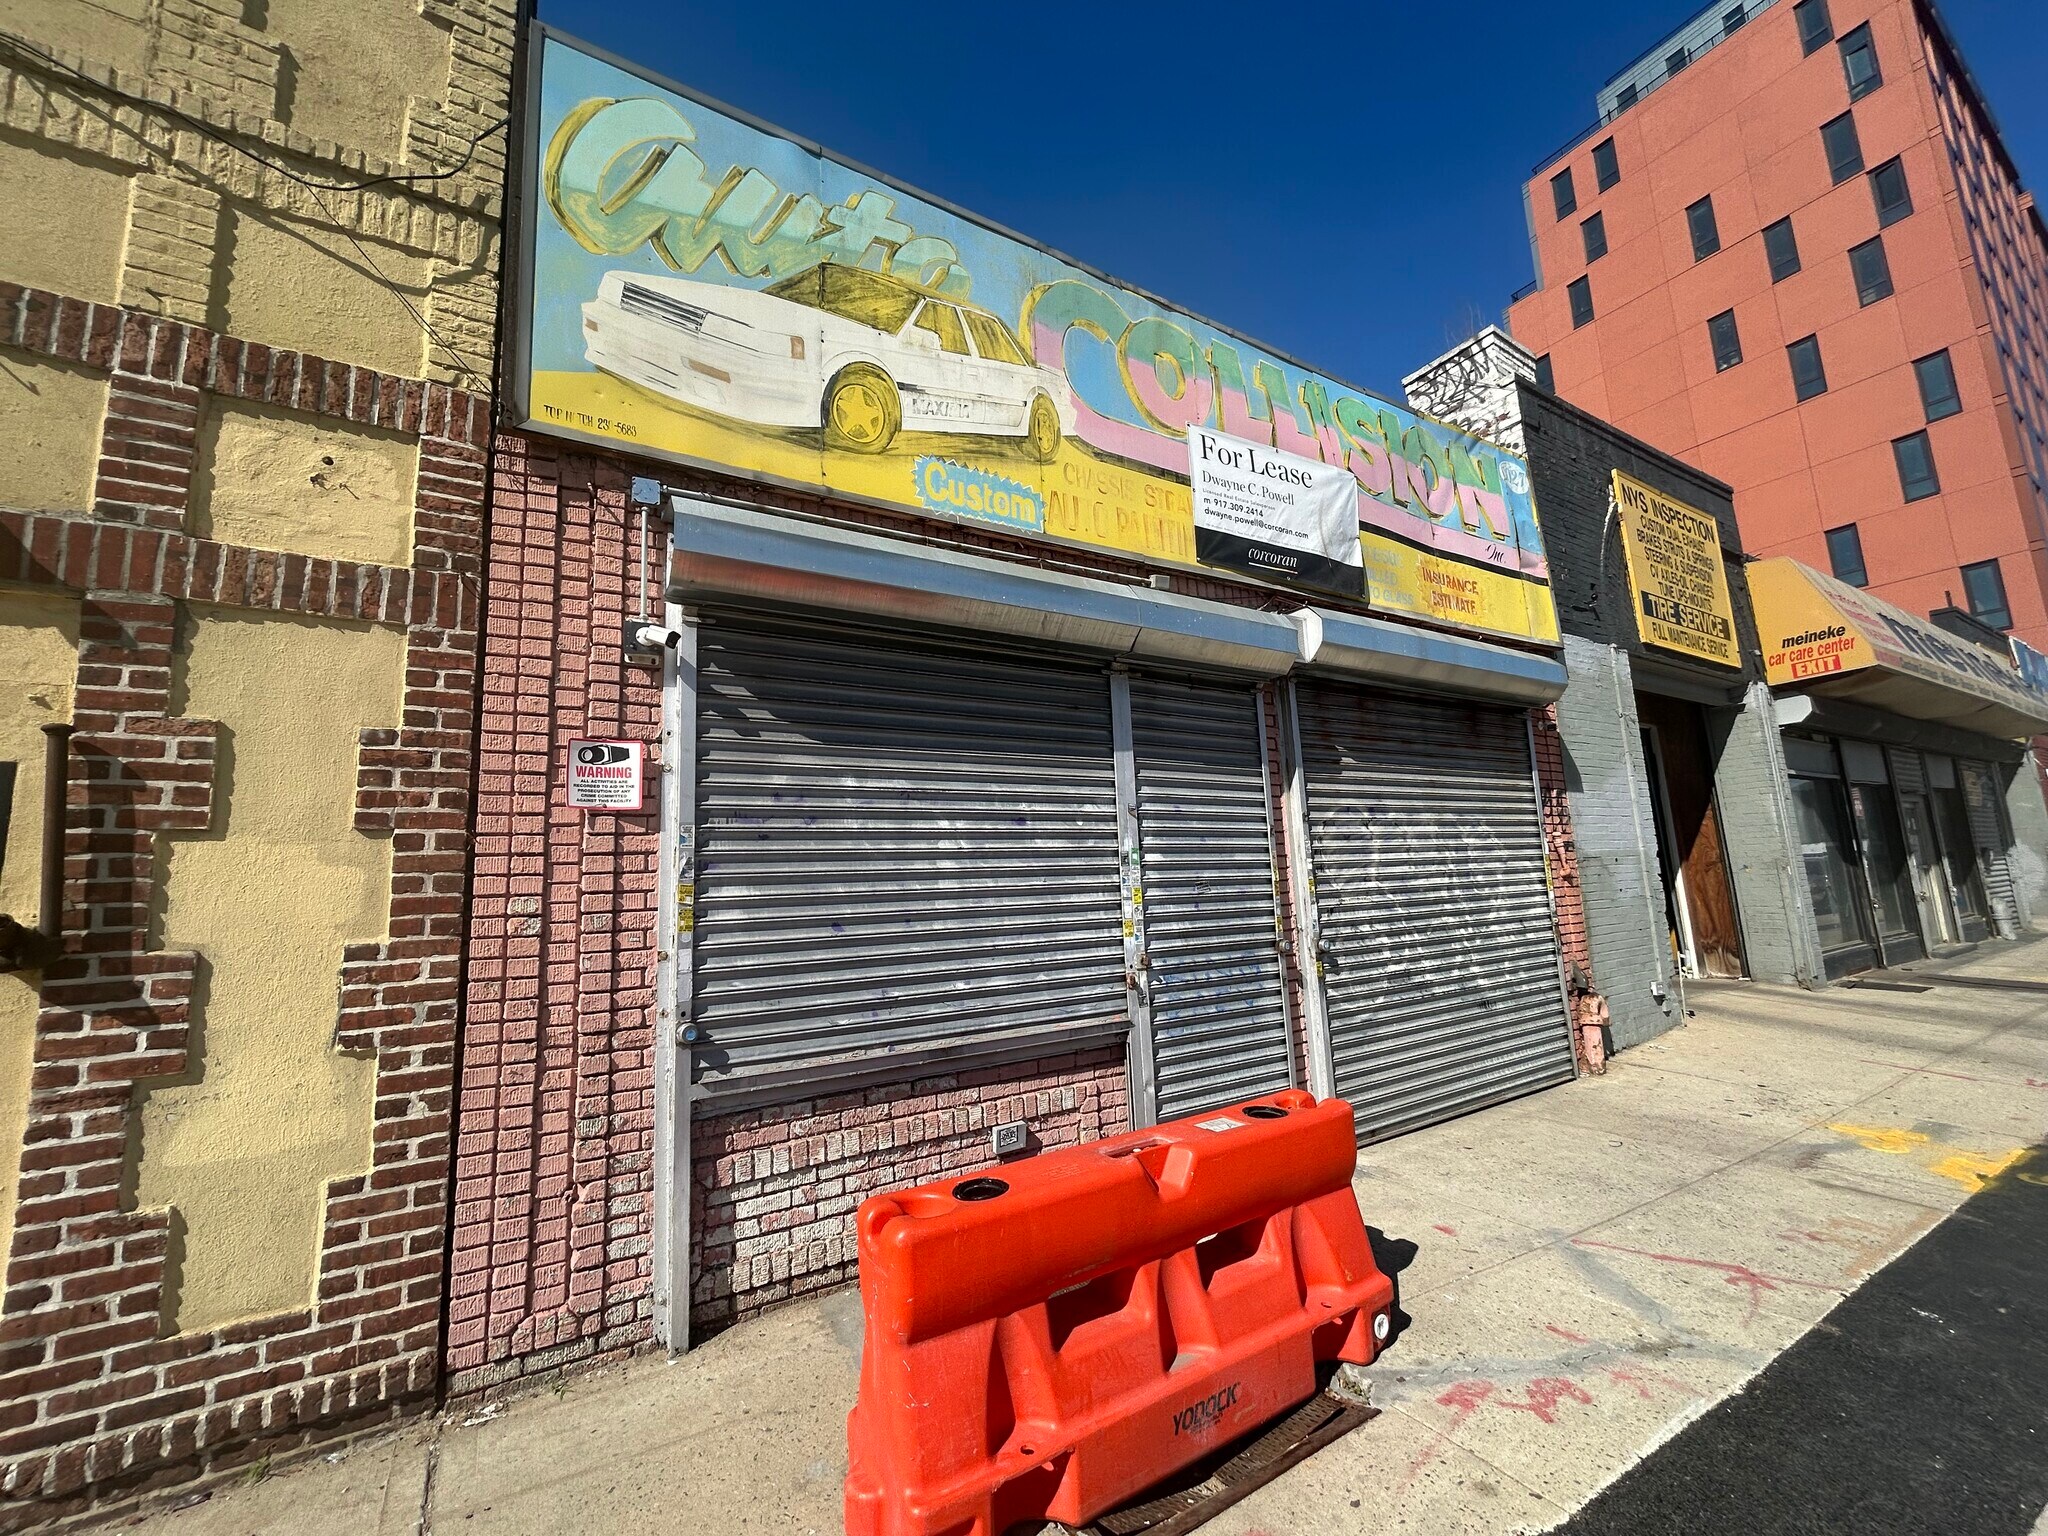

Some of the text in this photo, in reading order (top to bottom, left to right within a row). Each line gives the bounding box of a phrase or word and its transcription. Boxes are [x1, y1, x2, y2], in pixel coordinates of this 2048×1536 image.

[598, 418, 637, 438] 23-5683
[1200, 433, 1313, 489] For Lease
[924, 462, 1036, 524] Custom
[1202, 470, 1295, 506] Dwayne C. Powell
[1204, 507, 1309, 539] dwayne.powell@corcoran.com
[1213, 498, 1264, 517] 917.309.2414
[1621, 483, 1716, 545] NYS INSPECTION
[1636, 528, 1662, 551] BRAKES
[1663, 539, 1686, 560] STRUTS
[1691, 550, 1715, 572] SPRINGS
[1640, 514, 1707, 554] CUSTOM DUAL EXHAUST
[1248, 546, 1298, 568] corcoran
[1485, 543, 1507, 564] Inc.
[1644, 545, 1673, 570] STEERING
[1680, 560, 1714, 585] SUSPENSION
[1421, 567, 1479, 596] INSURANCE
[1650, 563, 1659, 579] CV
[1690, 578, 1715, 600] CHANGES
[1658, 581, 1676, 600] TUNE
[1431, 590, 1478, 616] ESTIMATE
[1648, 594, 1725, 638] TIRE SERVICE
[1652, 622, 1729, 659] FULL MAINTENANCE SERVICE
[1768, 652, 1786, 667] car
[1789, 646, 1814, 662] care
[1817, 636, 1856, 656] center
[1782, 625, 1846, 649] meineke
[1796, 655, 1836, 677] EXIT
[575, 765, 632, 778] WARNING
[1172, 1382, 1240, 1436] YODOCK
